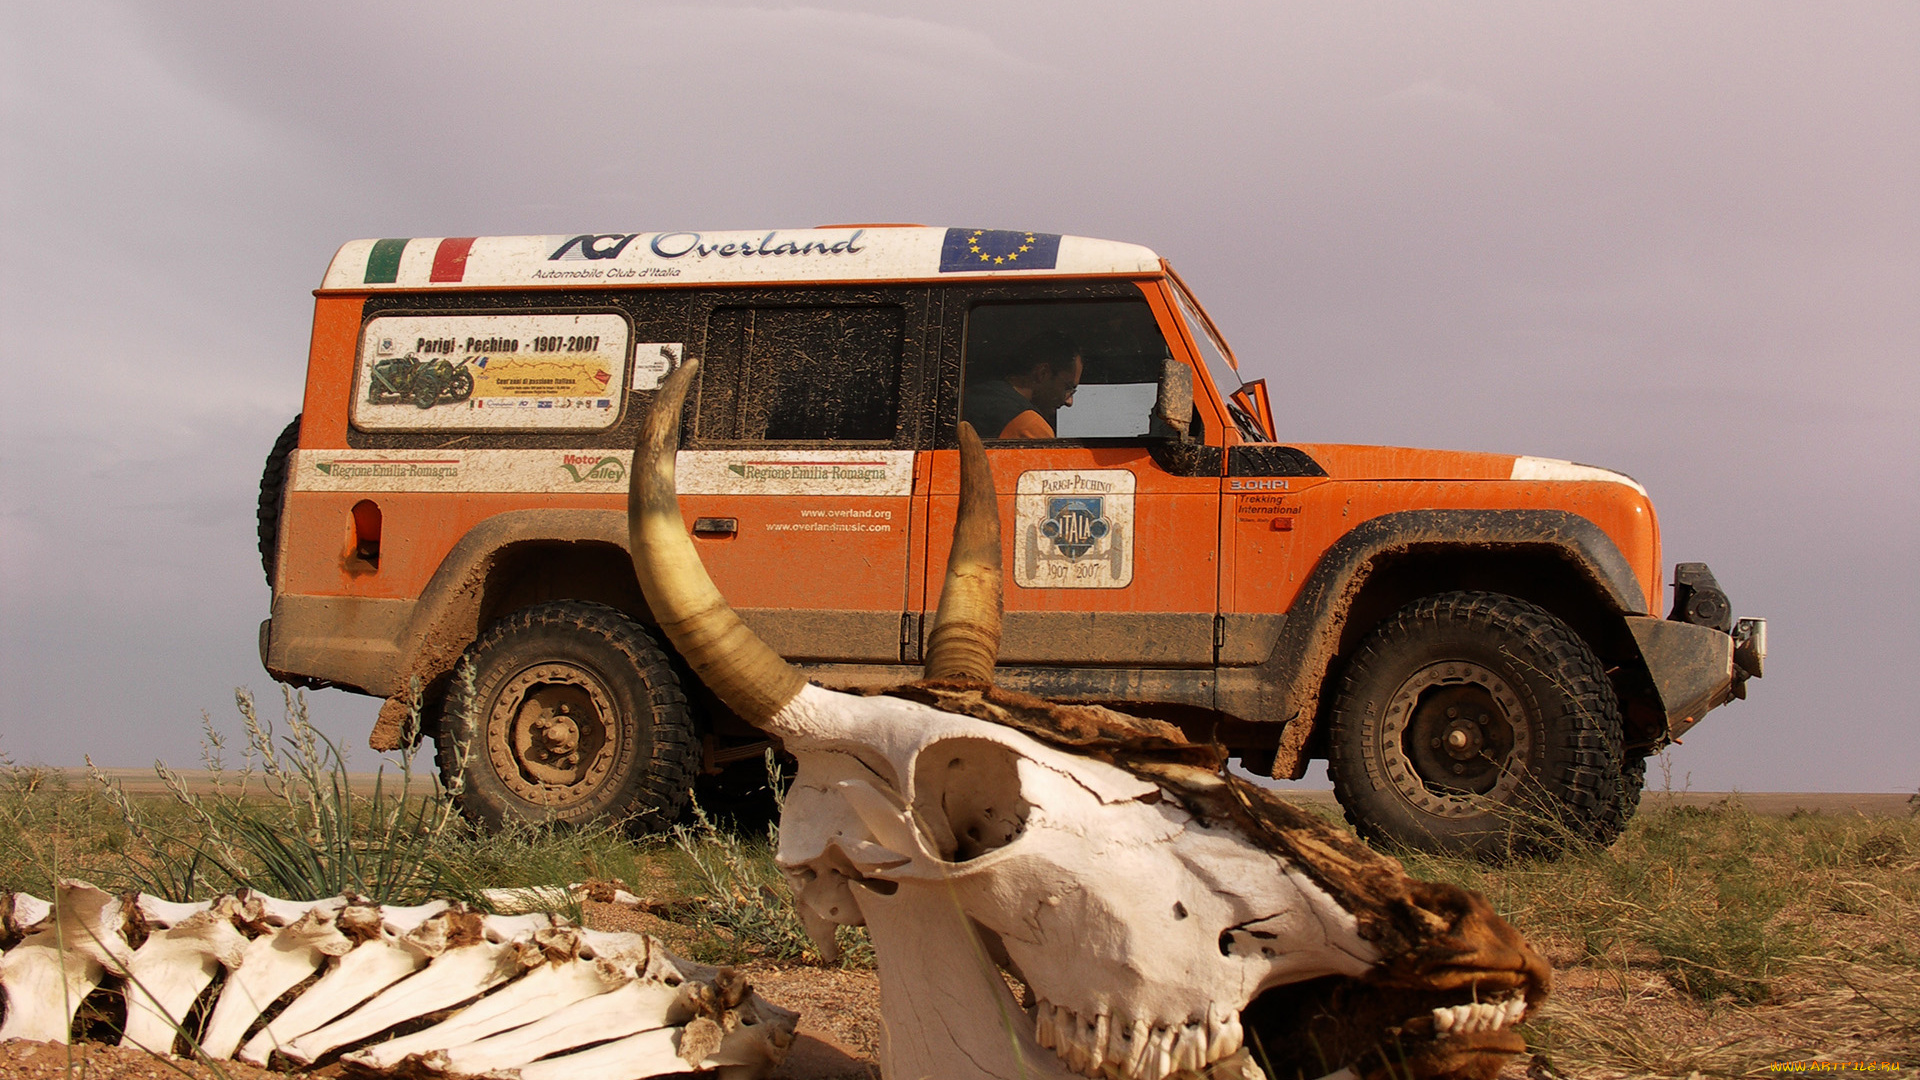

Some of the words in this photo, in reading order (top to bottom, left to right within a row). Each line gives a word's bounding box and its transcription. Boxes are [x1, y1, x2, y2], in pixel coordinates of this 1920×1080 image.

[650, 230, 866, 259] Overland
[531, 268, 603, 279] Automobile
[606, 268, 636, 278] Club
[638, 267, 681, 278] d'Italia
[416, 337, 456, 354] Parigi
[466, 336, 519, 353] Pechino
[533, 335, 600, 353] 1907-2007
[563, 454, 602, 465] Motor
[559, 456, 627, 484] Valley
[1240, 495, 1284, 505] Trekking
[800, 508, 892, 520] www.overland.org
[1238, 506, 1302, 515] International
[765, 522, 891, 533] www.overlandmusic.com
[1059, 512, 1092, 544] ITALA
[1047, 563, 1069, 579] 1907
[1076, 563, 1100, 579] 2007
[596, 710, 634, 803] SCORPION
[1361, 719, 1384, 791] PIRELLI
[556, 799, 595, 819] MUD
